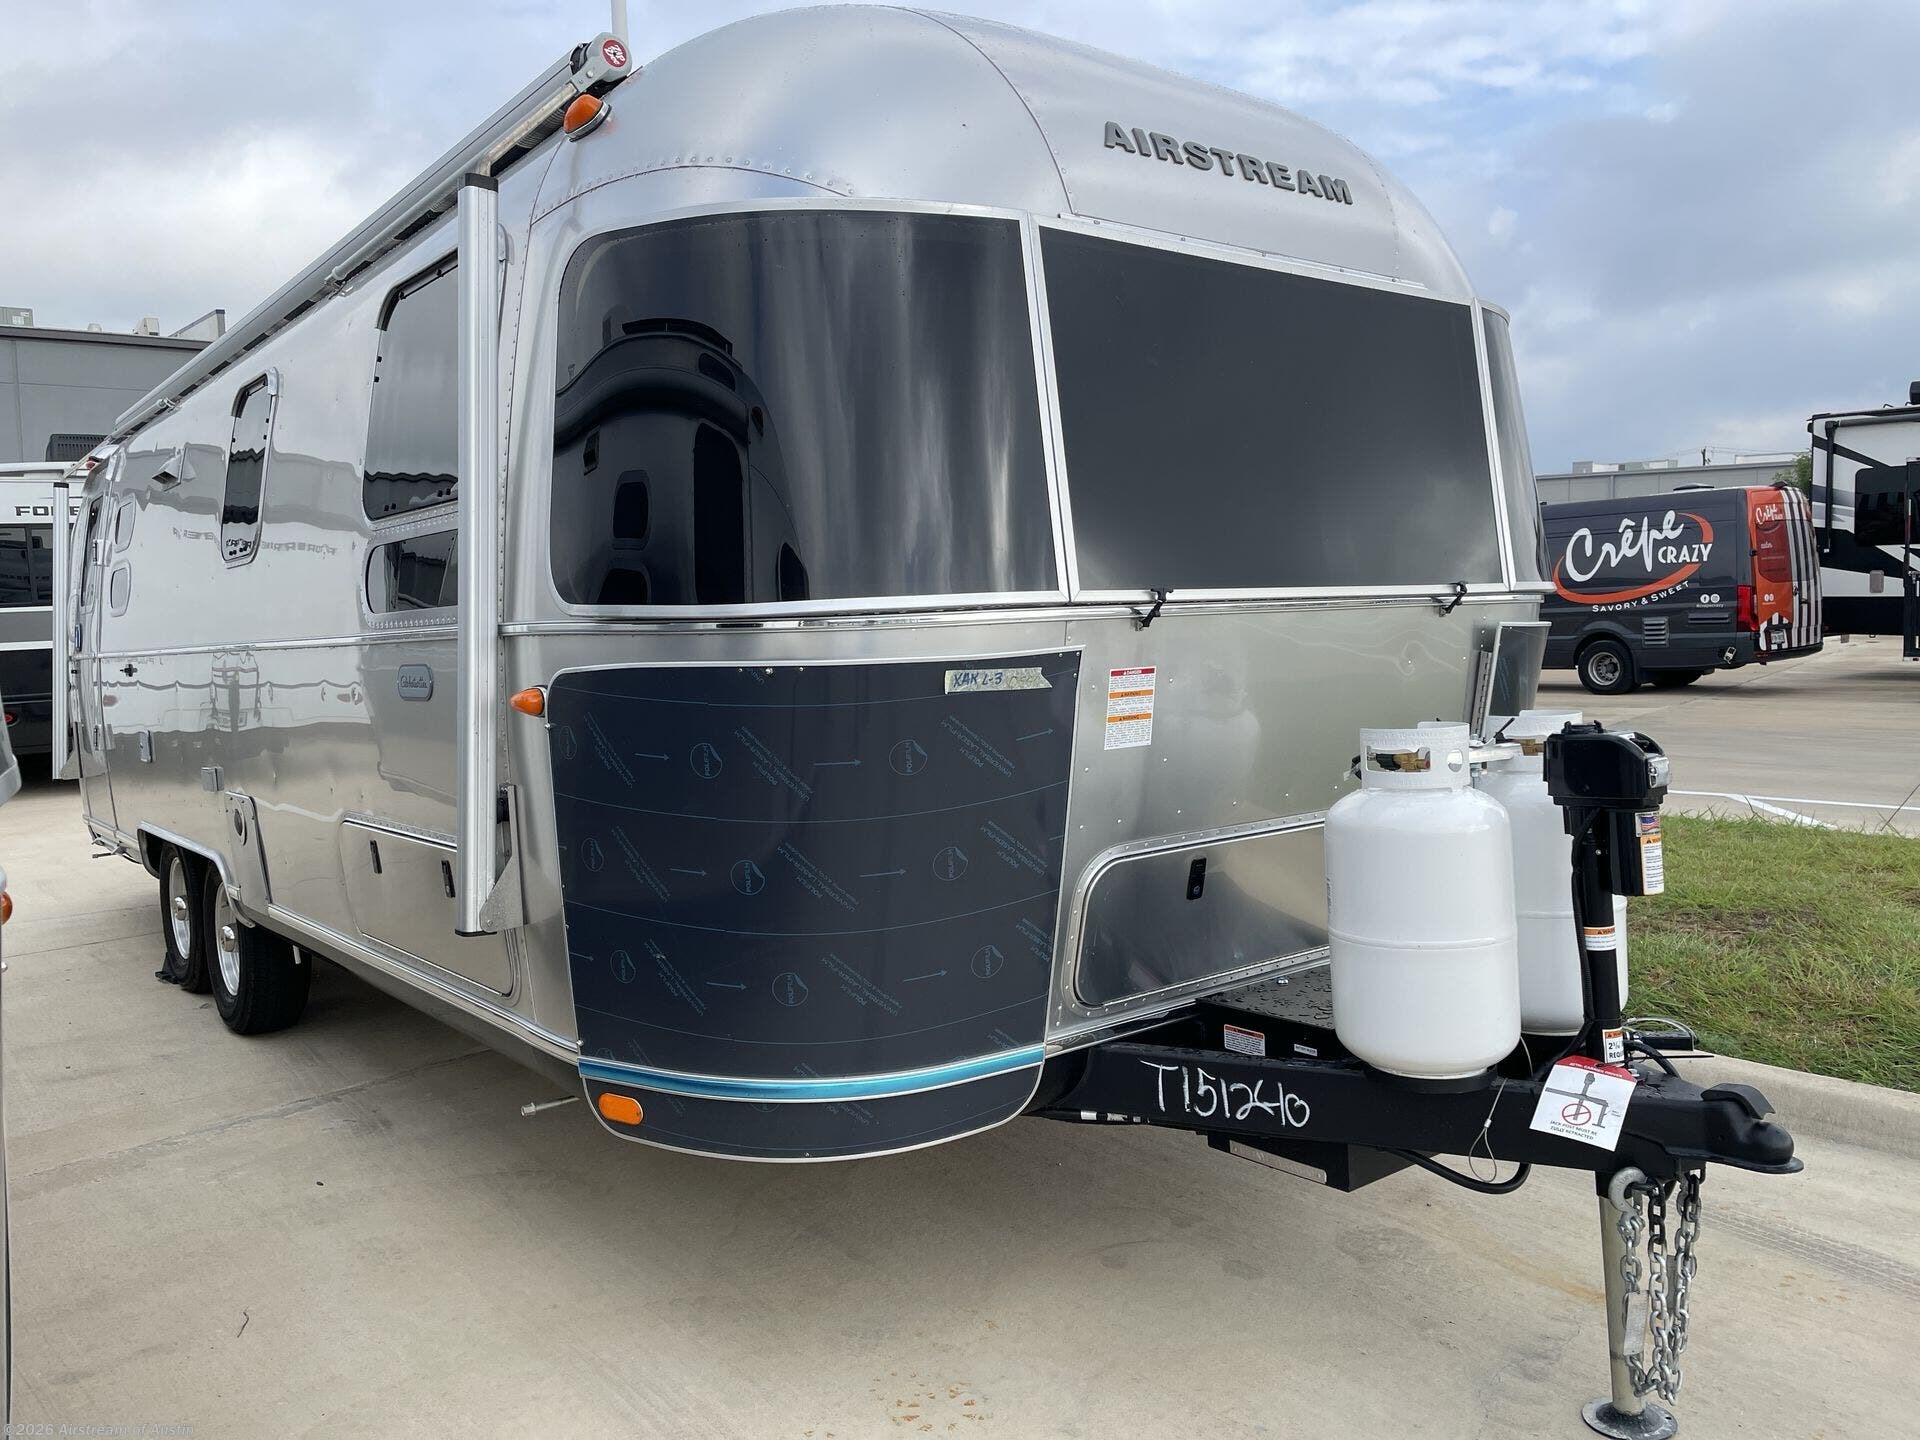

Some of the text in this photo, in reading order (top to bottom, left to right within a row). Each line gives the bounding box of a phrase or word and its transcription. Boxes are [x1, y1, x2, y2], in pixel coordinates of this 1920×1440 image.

[1104, 121, 1353, 205] AIRSTREAM
[15, 506, 80, 516] FOE
[1565, 510, 1684, 582] Crêpe
[1657, 543, 1713, 564] CRAZY
[1592, 580, 1689, 613] SAVORY & SWEET
